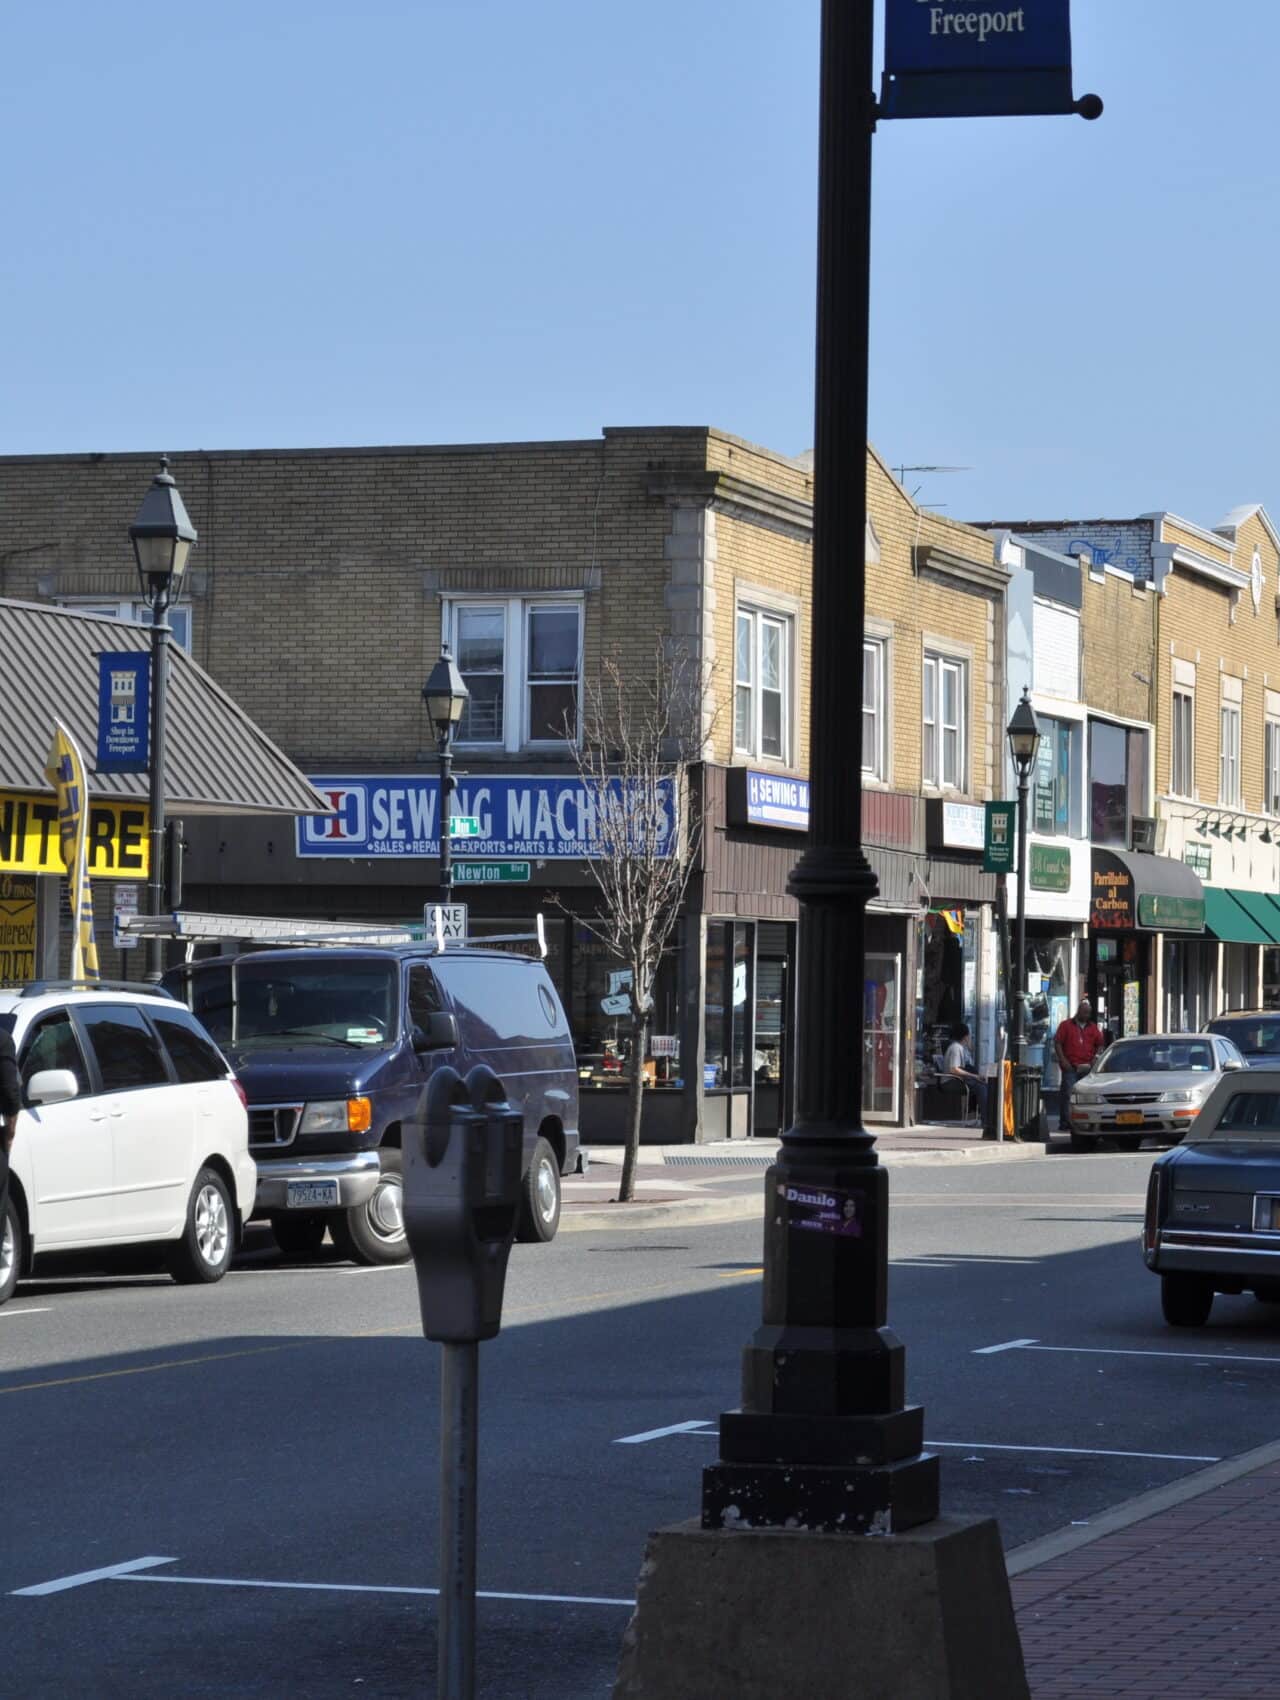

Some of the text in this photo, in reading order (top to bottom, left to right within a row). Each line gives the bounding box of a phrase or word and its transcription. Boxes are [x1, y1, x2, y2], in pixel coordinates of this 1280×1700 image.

[929, 7, 1024, 42] Freeport
[760, 777, 798, 807] SEWING
[372, 788, 492, 840] SEWNG
[0, 799, 145, 869] NITRE
[374, 841, 405, 853] SALES
[412, 841, 454, 854] REPAIS
[461, 841, 506, 853] EXPORTS
[514, 841, 546, 854] PARTS
[456, 863, 525, 880] Newton Blvd
[1108, 886, 1117, 899] al
[786, 1188, 836, 1208] Danilo
